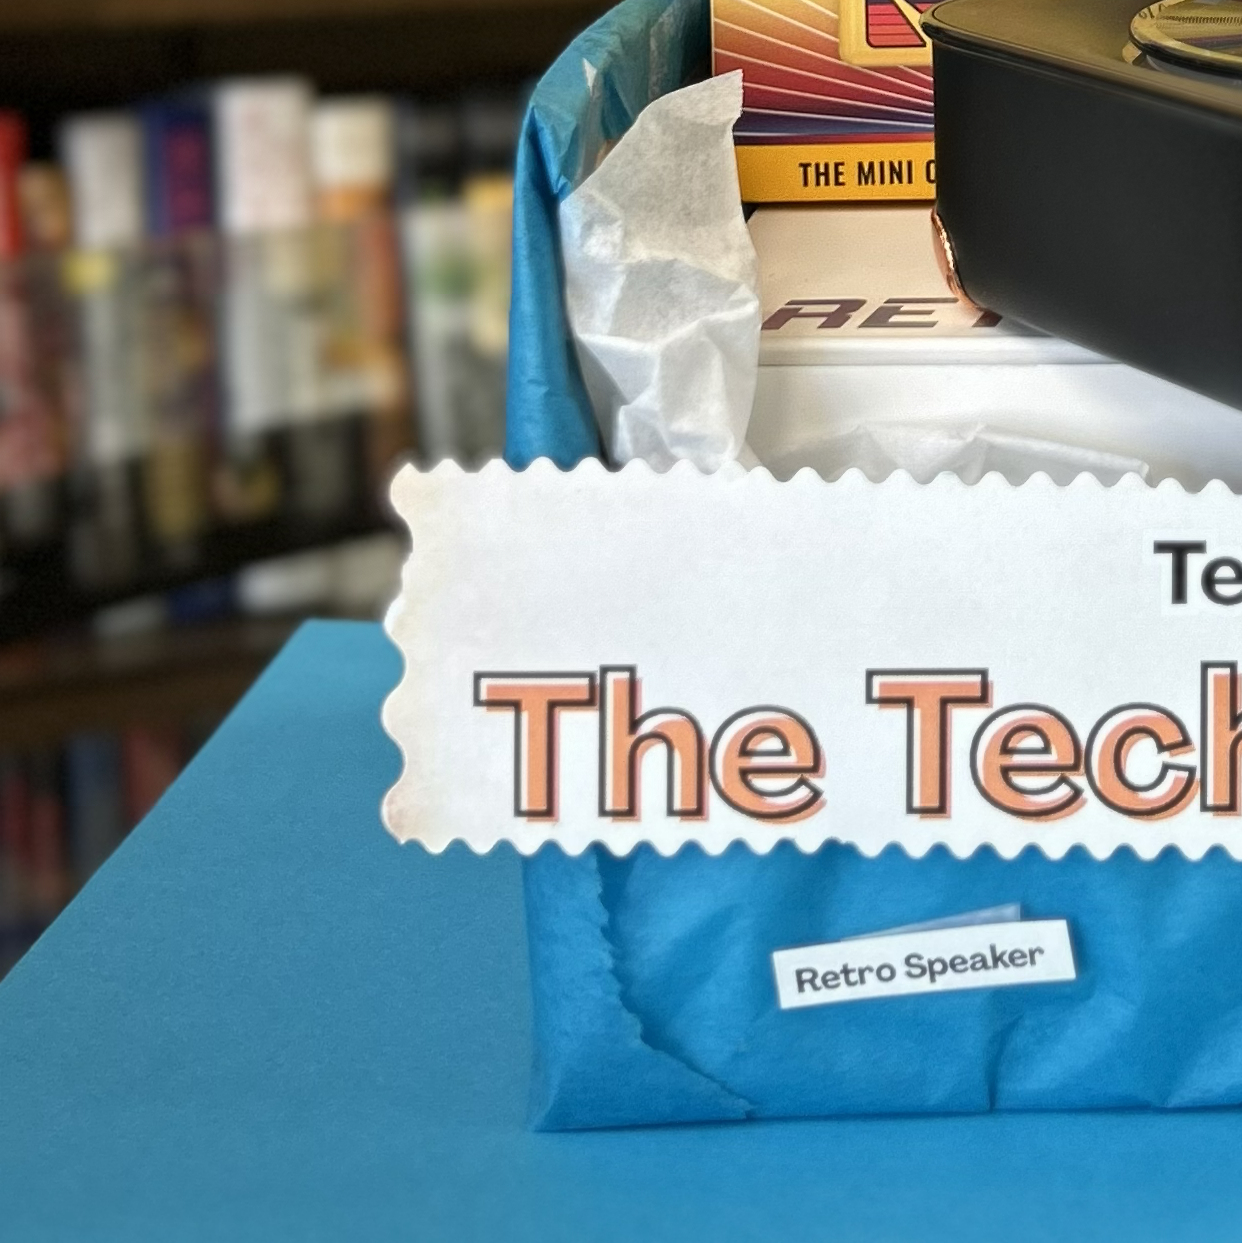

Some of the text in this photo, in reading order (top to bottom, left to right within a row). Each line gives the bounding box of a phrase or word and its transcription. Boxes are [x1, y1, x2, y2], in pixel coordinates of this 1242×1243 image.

[799, 162, 845, 187] THE
[857, 160, 913, 186] MINI
[473, 664, 826, 825] The
[795, 944, 1045, 993] Retro Speaker
